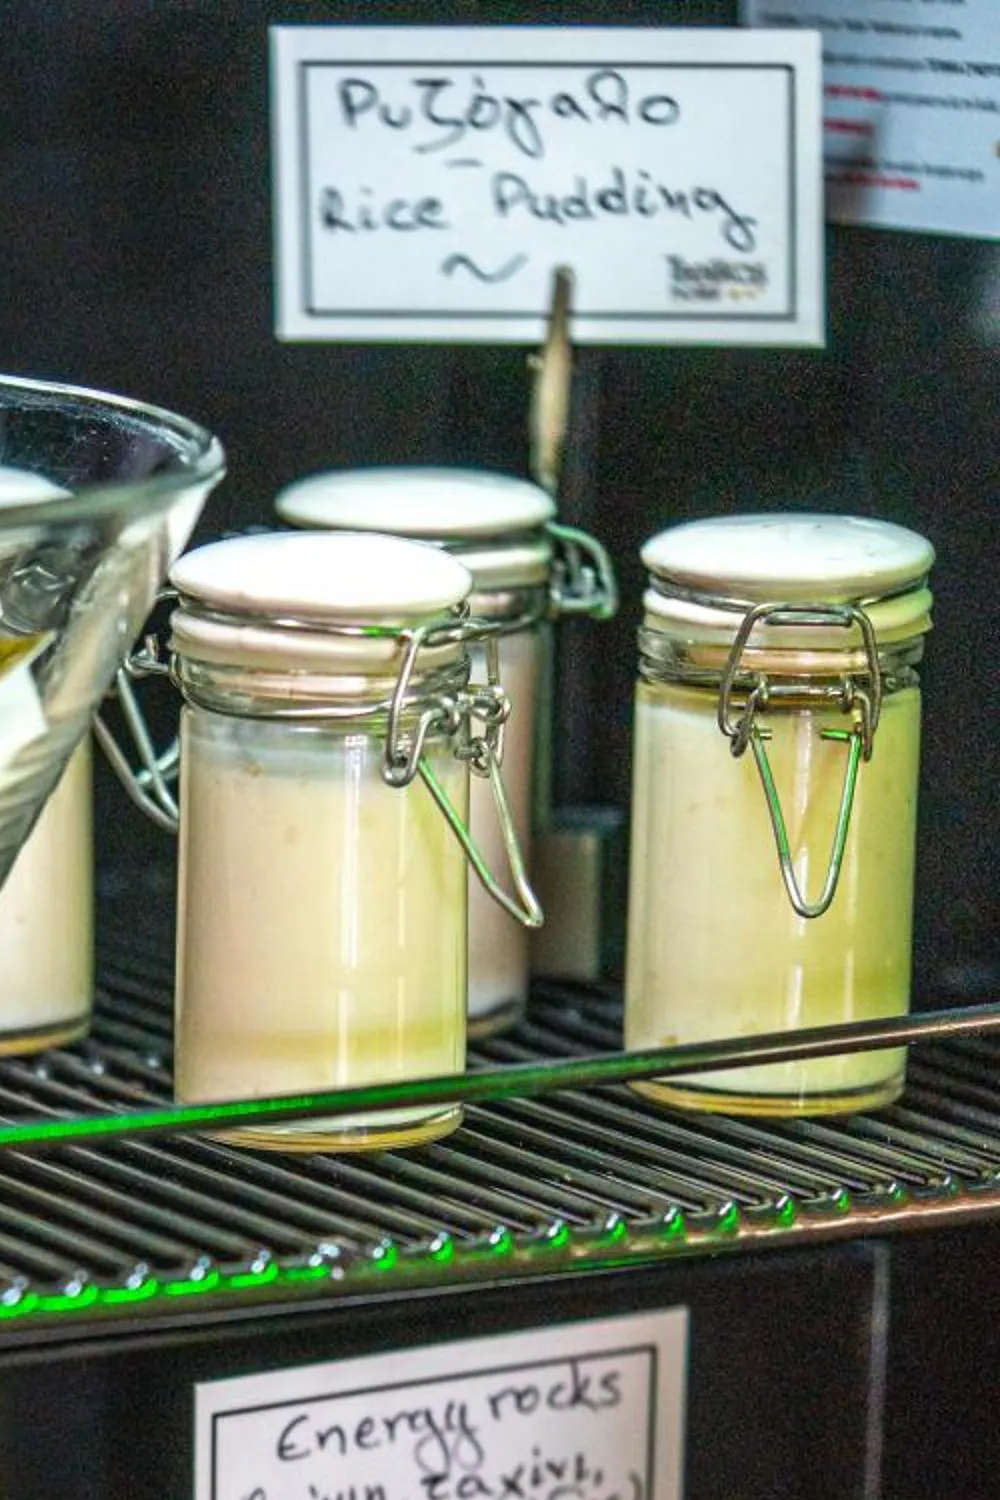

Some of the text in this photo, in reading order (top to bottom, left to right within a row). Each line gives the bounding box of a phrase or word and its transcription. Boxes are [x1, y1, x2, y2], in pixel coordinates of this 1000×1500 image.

[318, 166, 757, 254] Rice Pudding
[275, 1359, 623, 1472] Energy rocks
